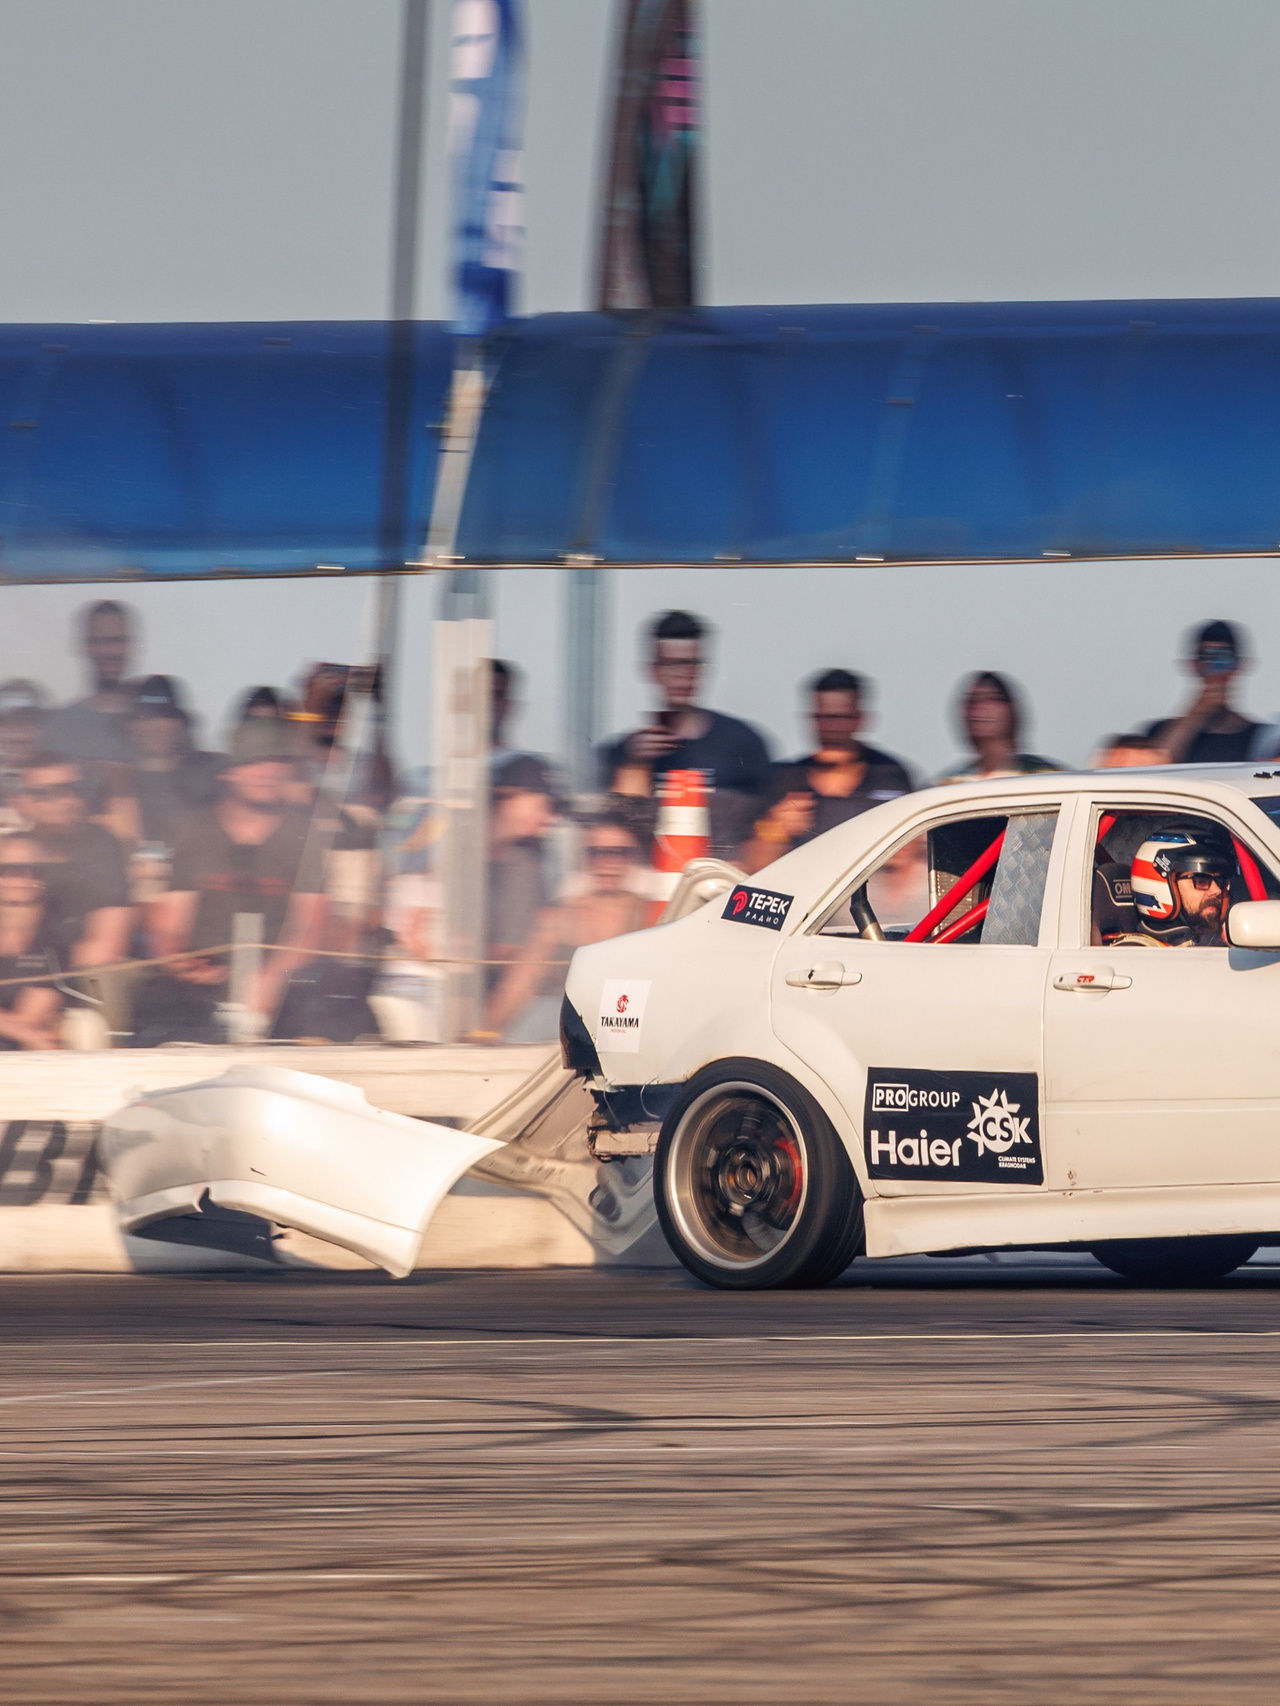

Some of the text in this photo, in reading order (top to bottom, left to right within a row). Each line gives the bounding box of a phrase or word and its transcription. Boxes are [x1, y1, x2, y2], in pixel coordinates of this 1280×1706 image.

[748, 892, 790, 915] ТЕРЕК
[745, 911, 779, 925] РАДИО
[600, 1016, 640, 1028] TAKAYAMA
[982, 1116, 1033, 1145] CSK
[870, 1129, 963, 1167] Haier
